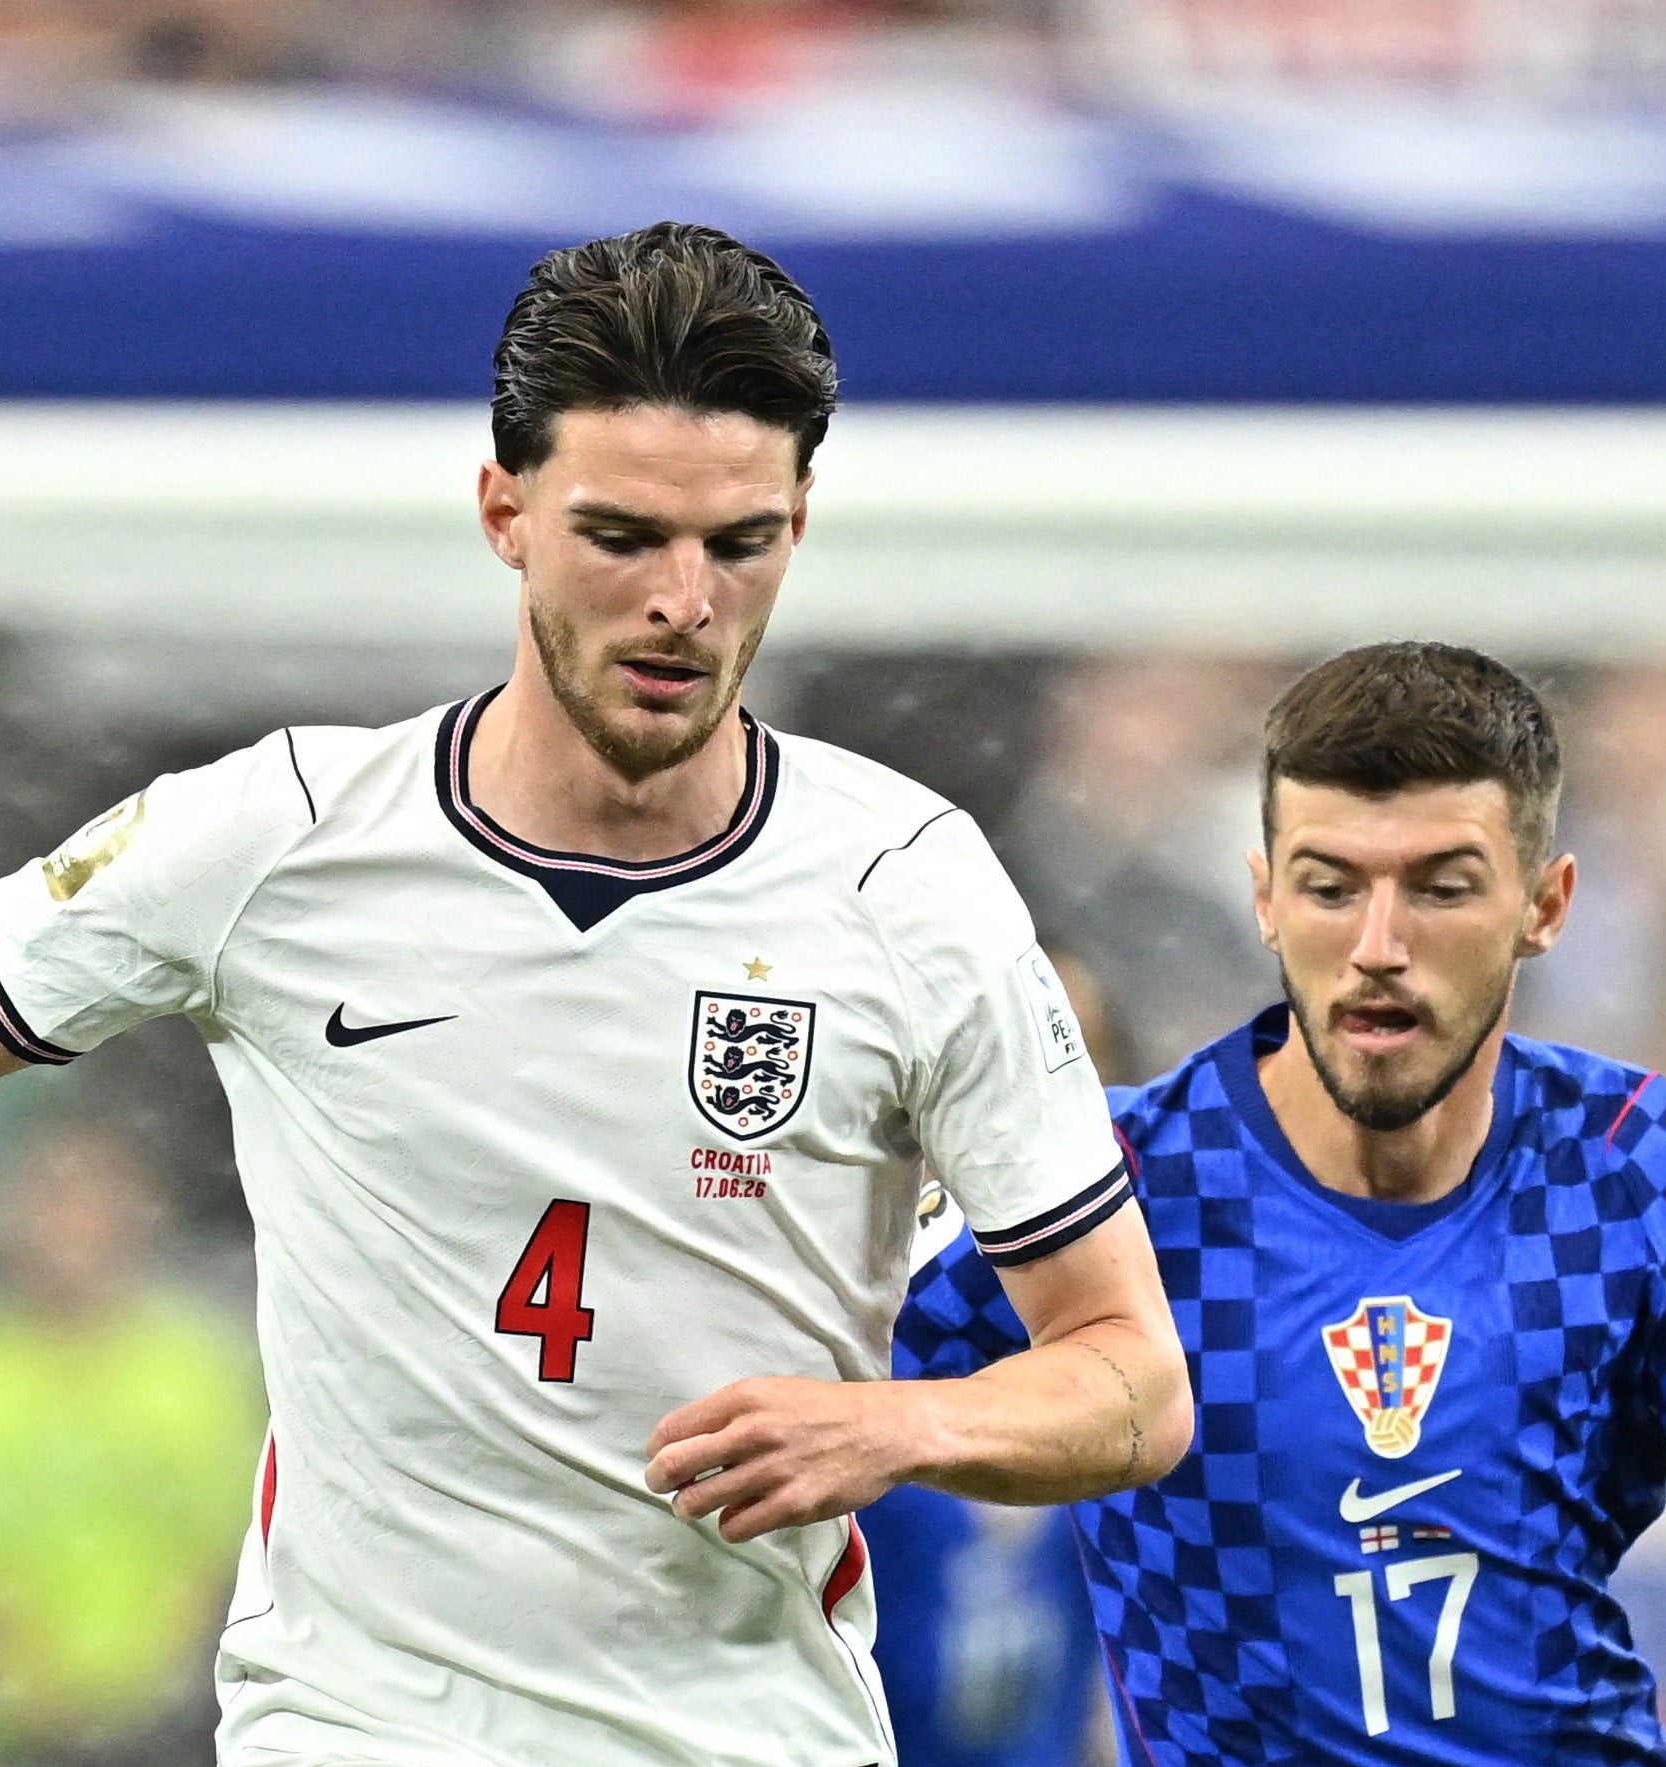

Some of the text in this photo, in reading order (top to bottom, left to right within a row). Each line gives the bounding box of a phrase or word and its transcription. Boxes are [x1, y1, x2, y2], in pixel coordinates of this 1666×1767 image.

[691, 1148, 772, 1175] CROATIA
[696, 1177, 767, 1199] 17.06.26
[493, 1197, 595, 1384] 4
[1333, 1552, 1479, 1737] 17
